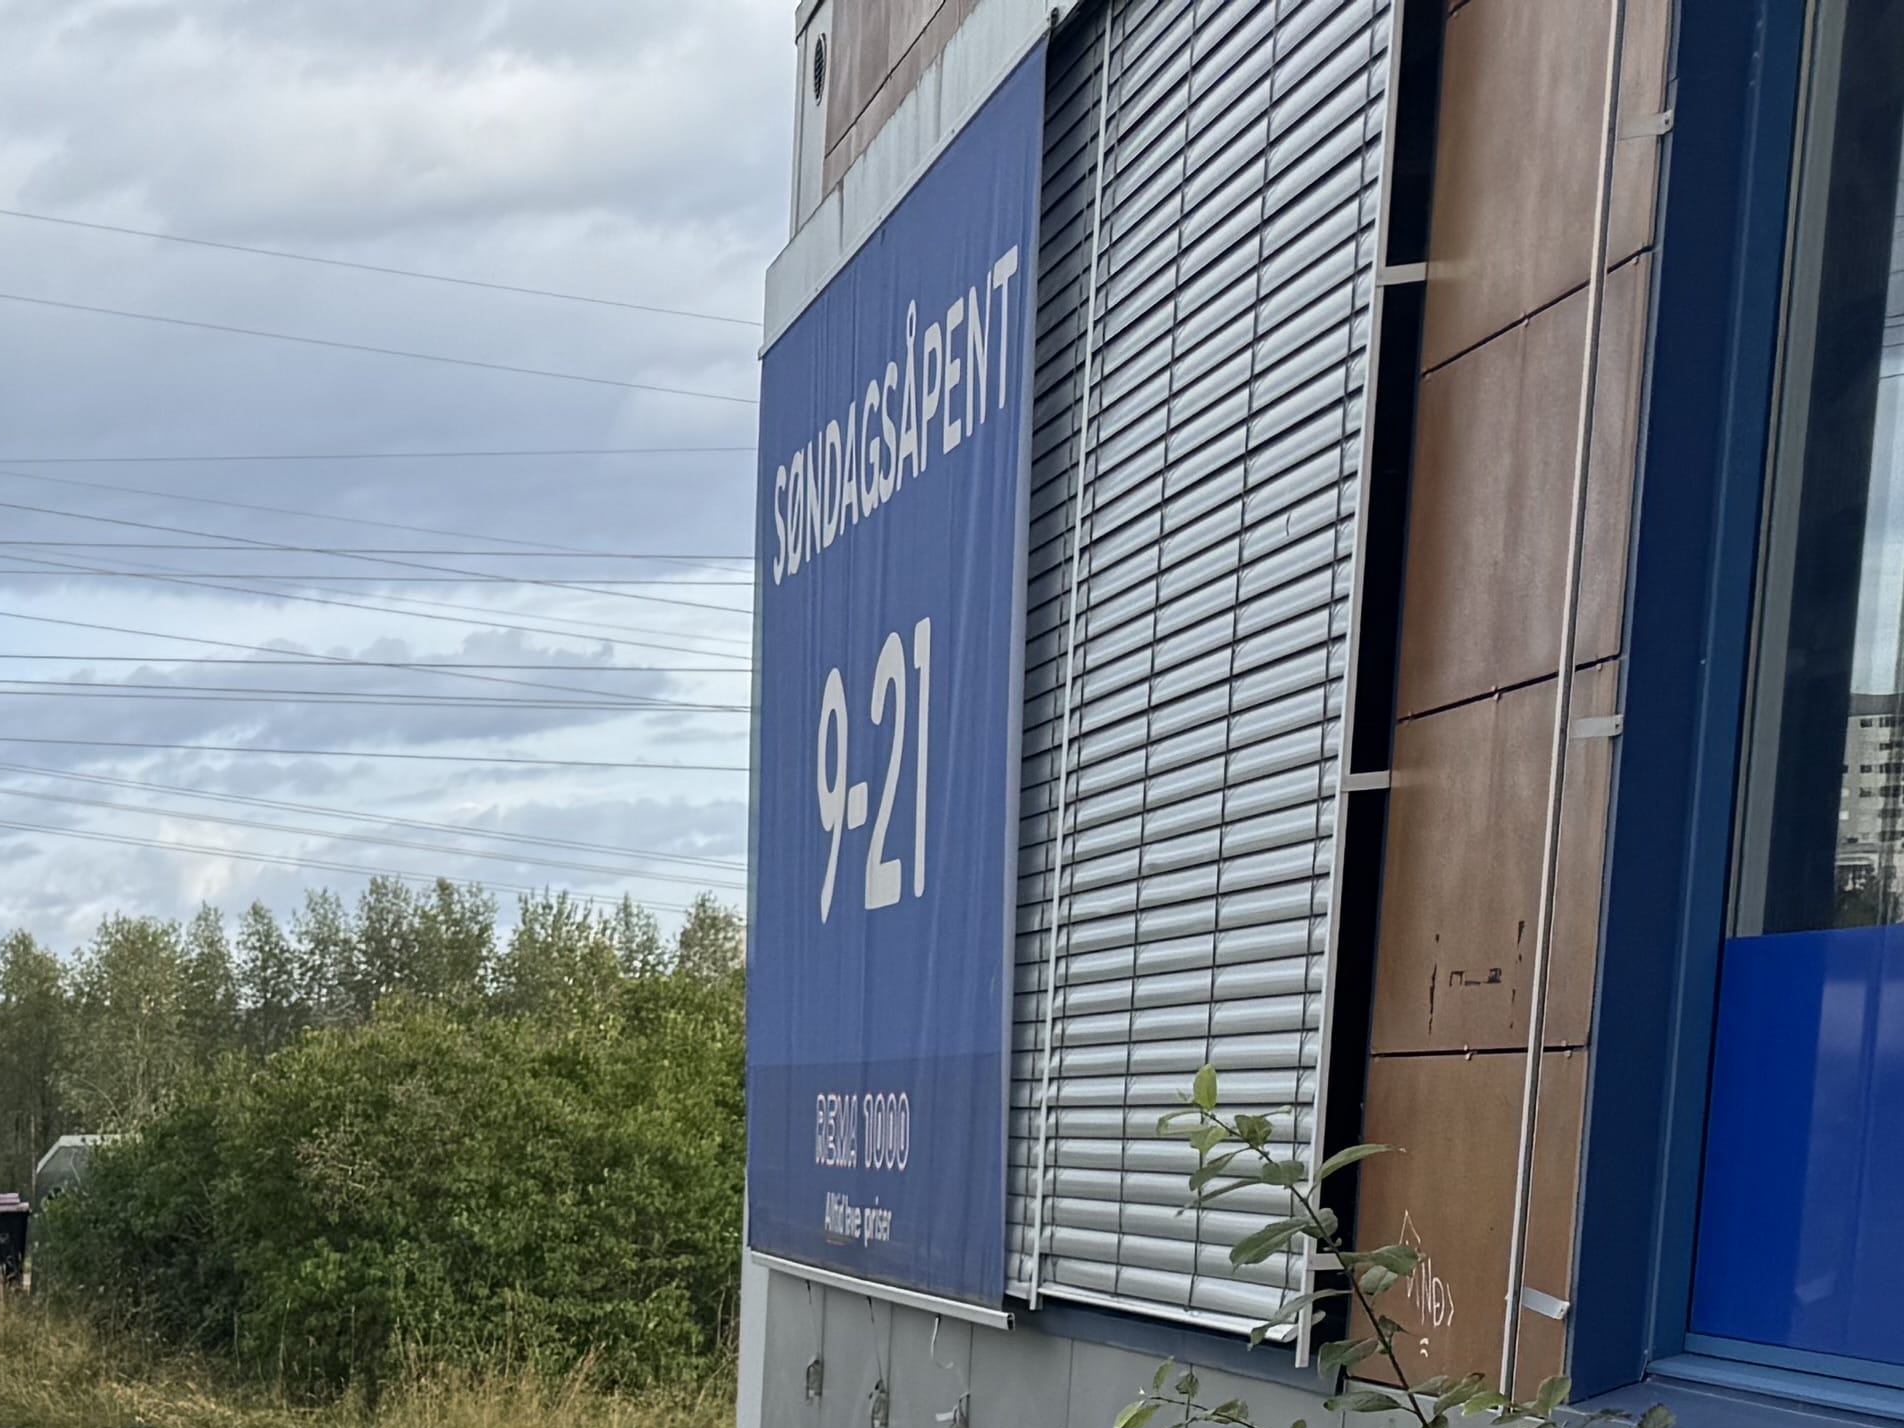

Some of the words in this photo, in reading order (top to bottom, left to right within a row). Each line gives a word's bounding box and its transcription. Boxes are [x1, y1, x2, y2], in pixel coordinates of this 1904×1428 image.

[773, 245, 1018, 586] SØNDAGSÅPENT
[816, 616, 931, 925] 9-21
[815, 1093, 858, 1168] REMA
[863, 1092, 910, 1171] 1000
[864, 1196, 892, 1247] priser
